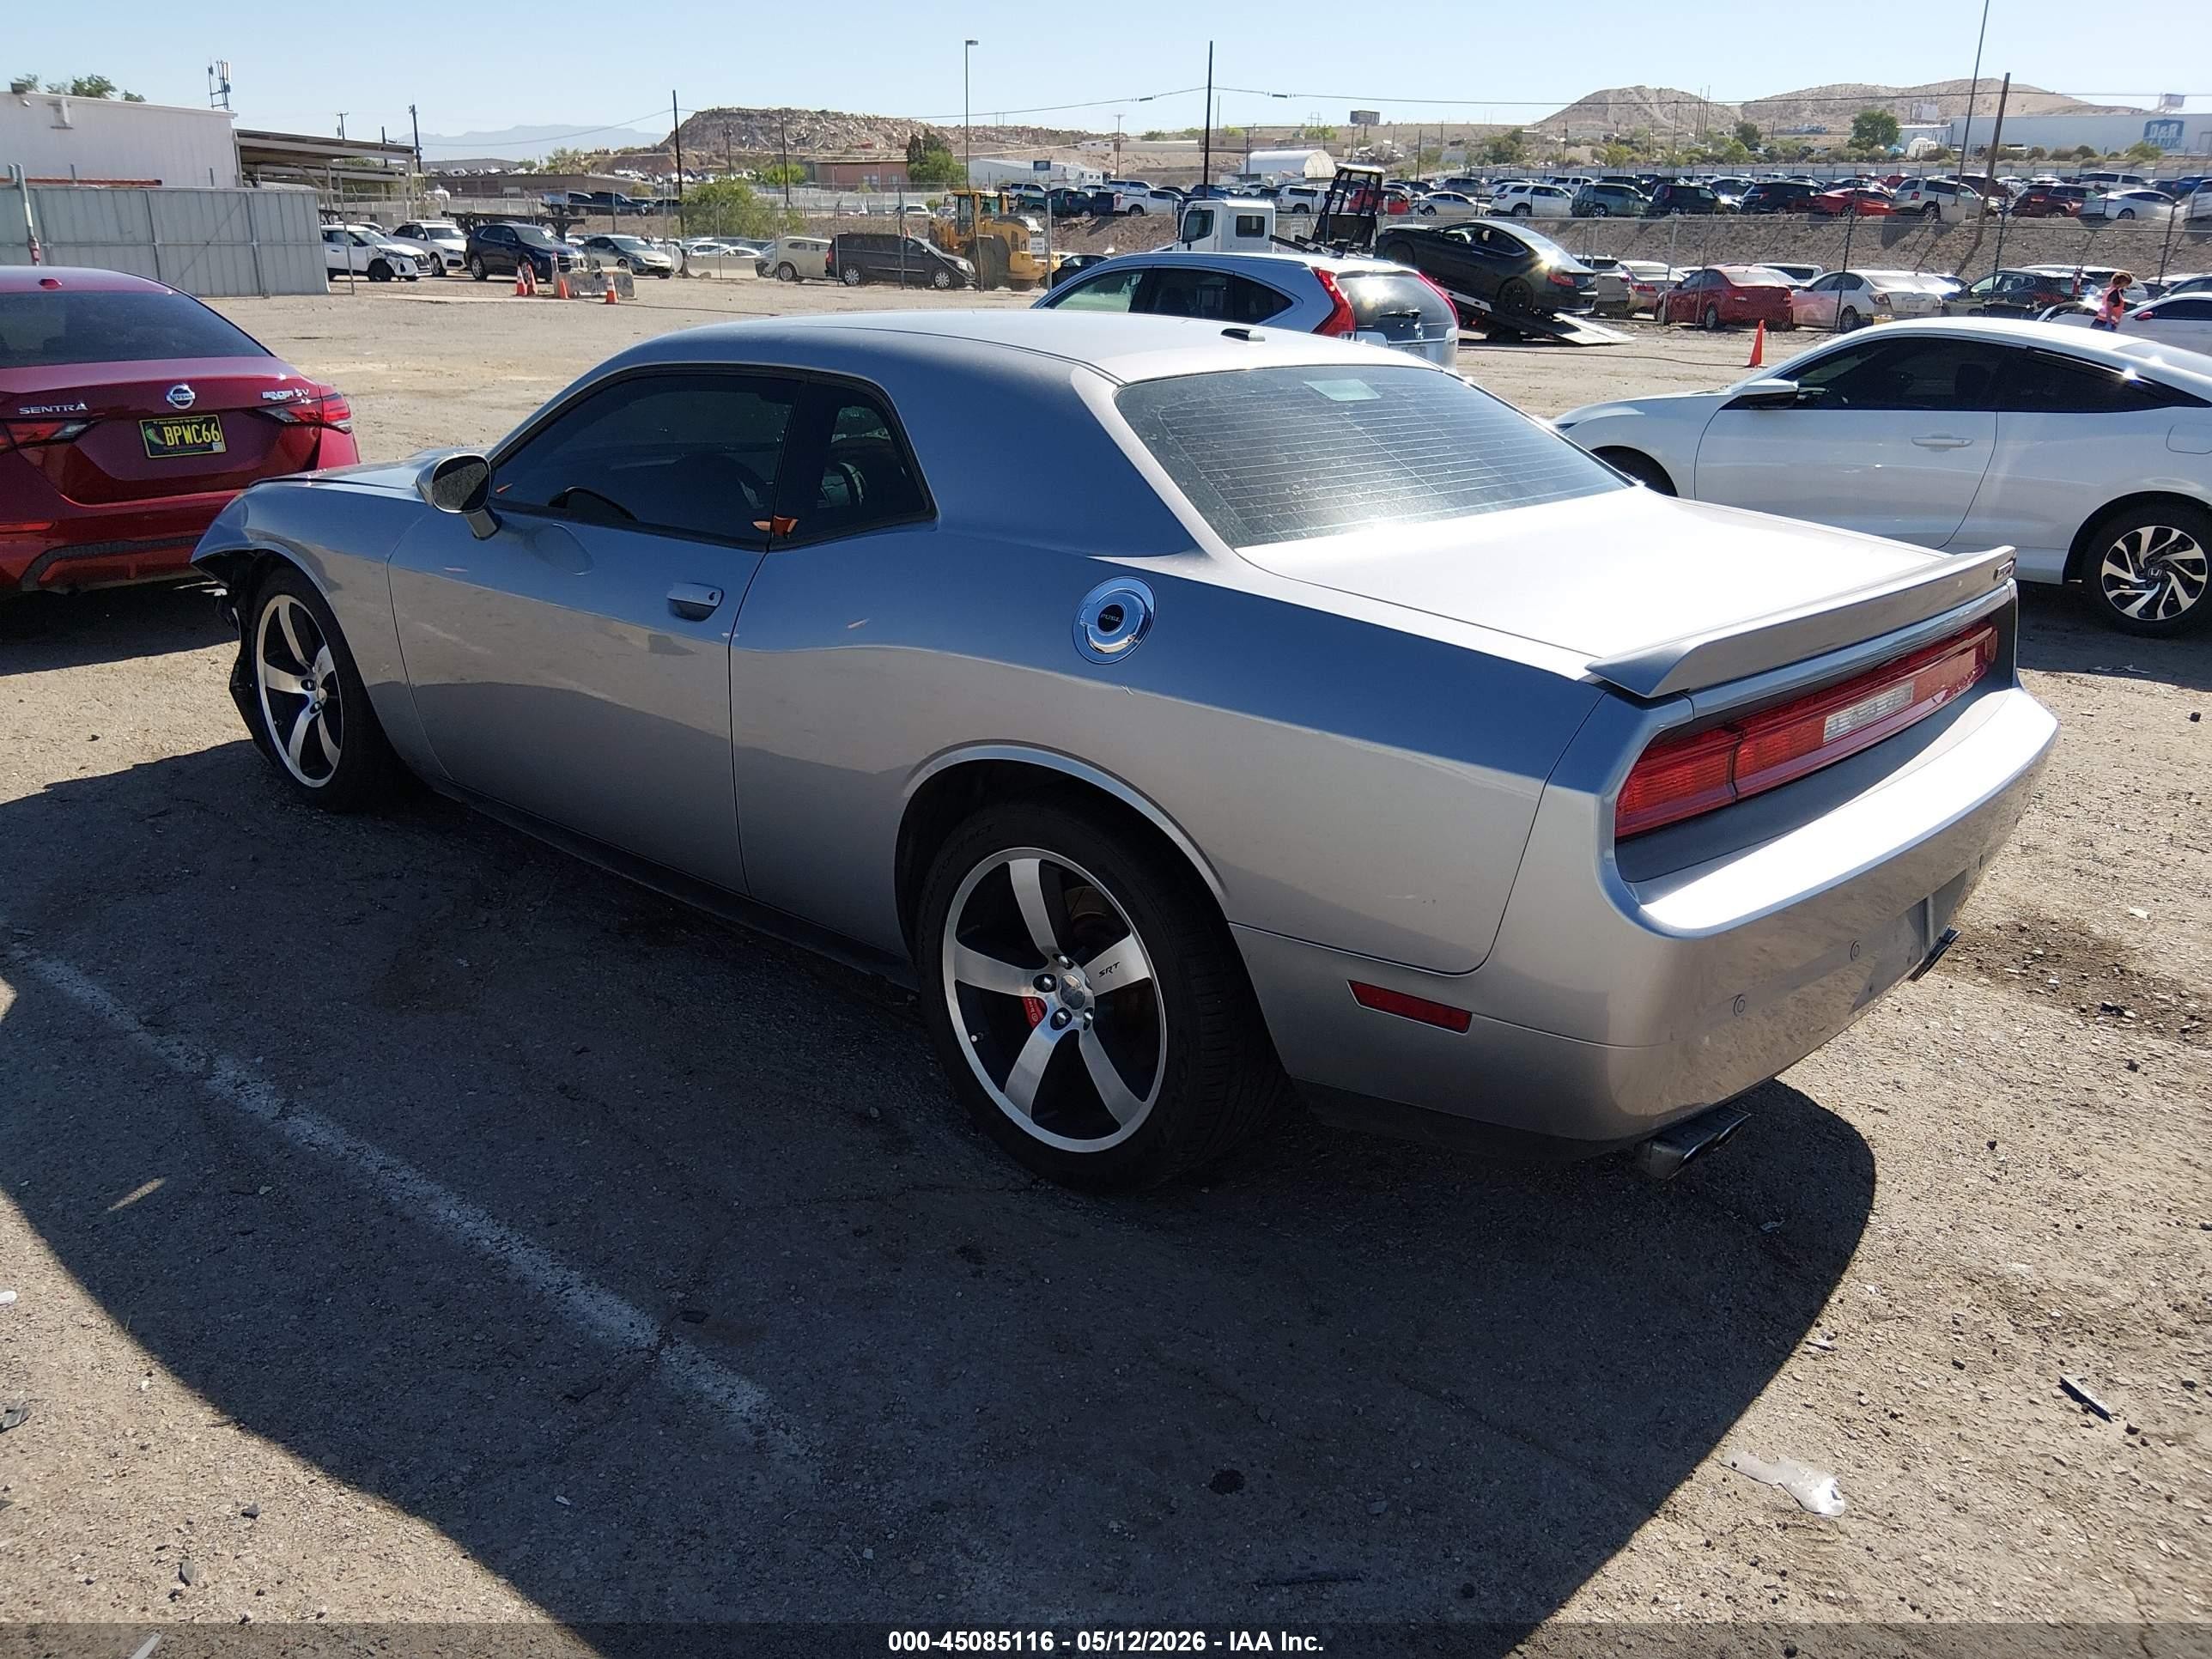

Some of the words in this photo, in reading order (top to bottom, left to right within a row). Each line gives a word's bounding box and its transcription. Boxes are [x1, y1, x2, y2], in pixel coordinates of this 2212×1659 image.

[19, 403, 88, 415] SENTRA
[163, 423, 221, 447] BPWC66
[1098, 961, 1121, 978] SRT
